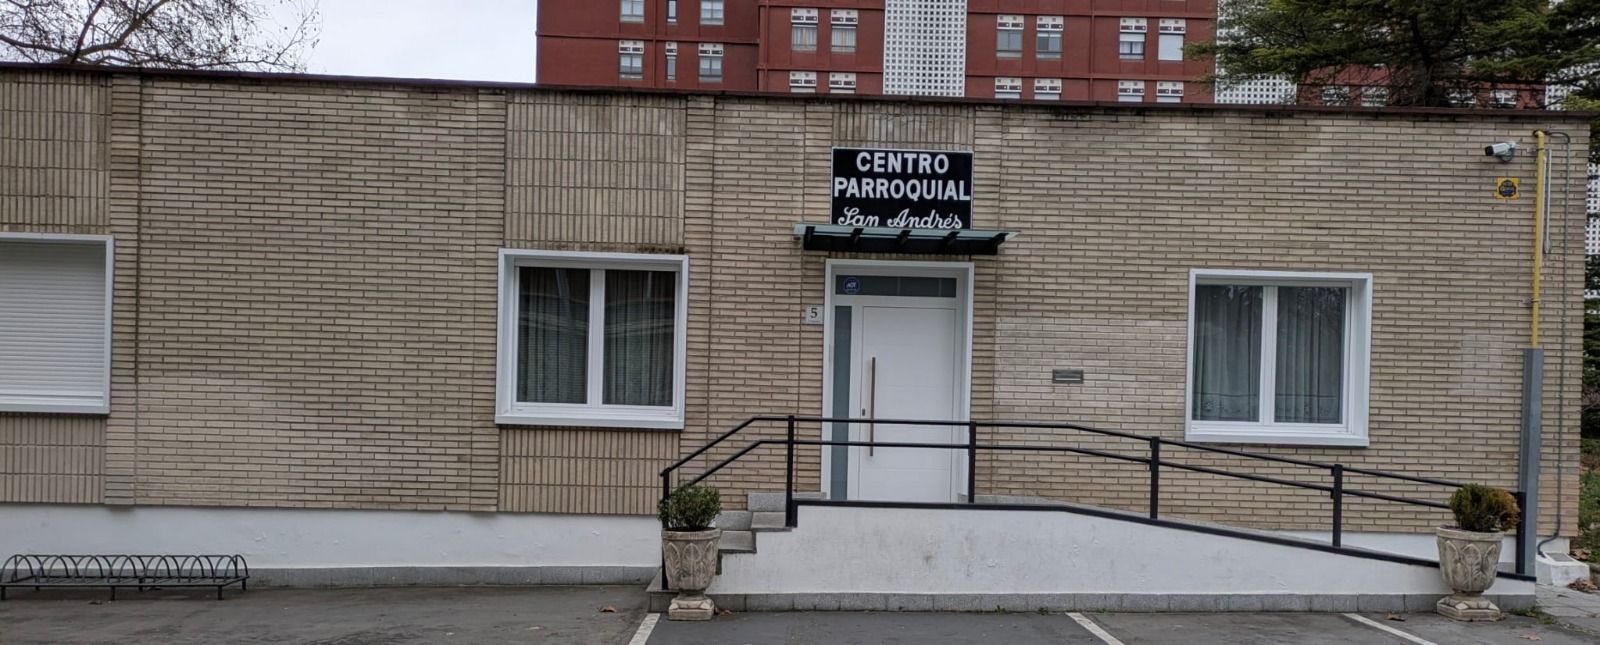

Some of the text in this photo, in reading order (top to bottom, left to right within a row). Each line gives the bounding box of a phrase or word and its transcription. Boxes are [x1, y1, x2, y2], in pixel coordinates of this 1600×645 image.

[856, 151, 949, 174] CENTRO
[834, 177, 971, 202] PARROQUIAL
[838, 206, 963, 229] San Andrés
[810, 307, 818, 318] 5
